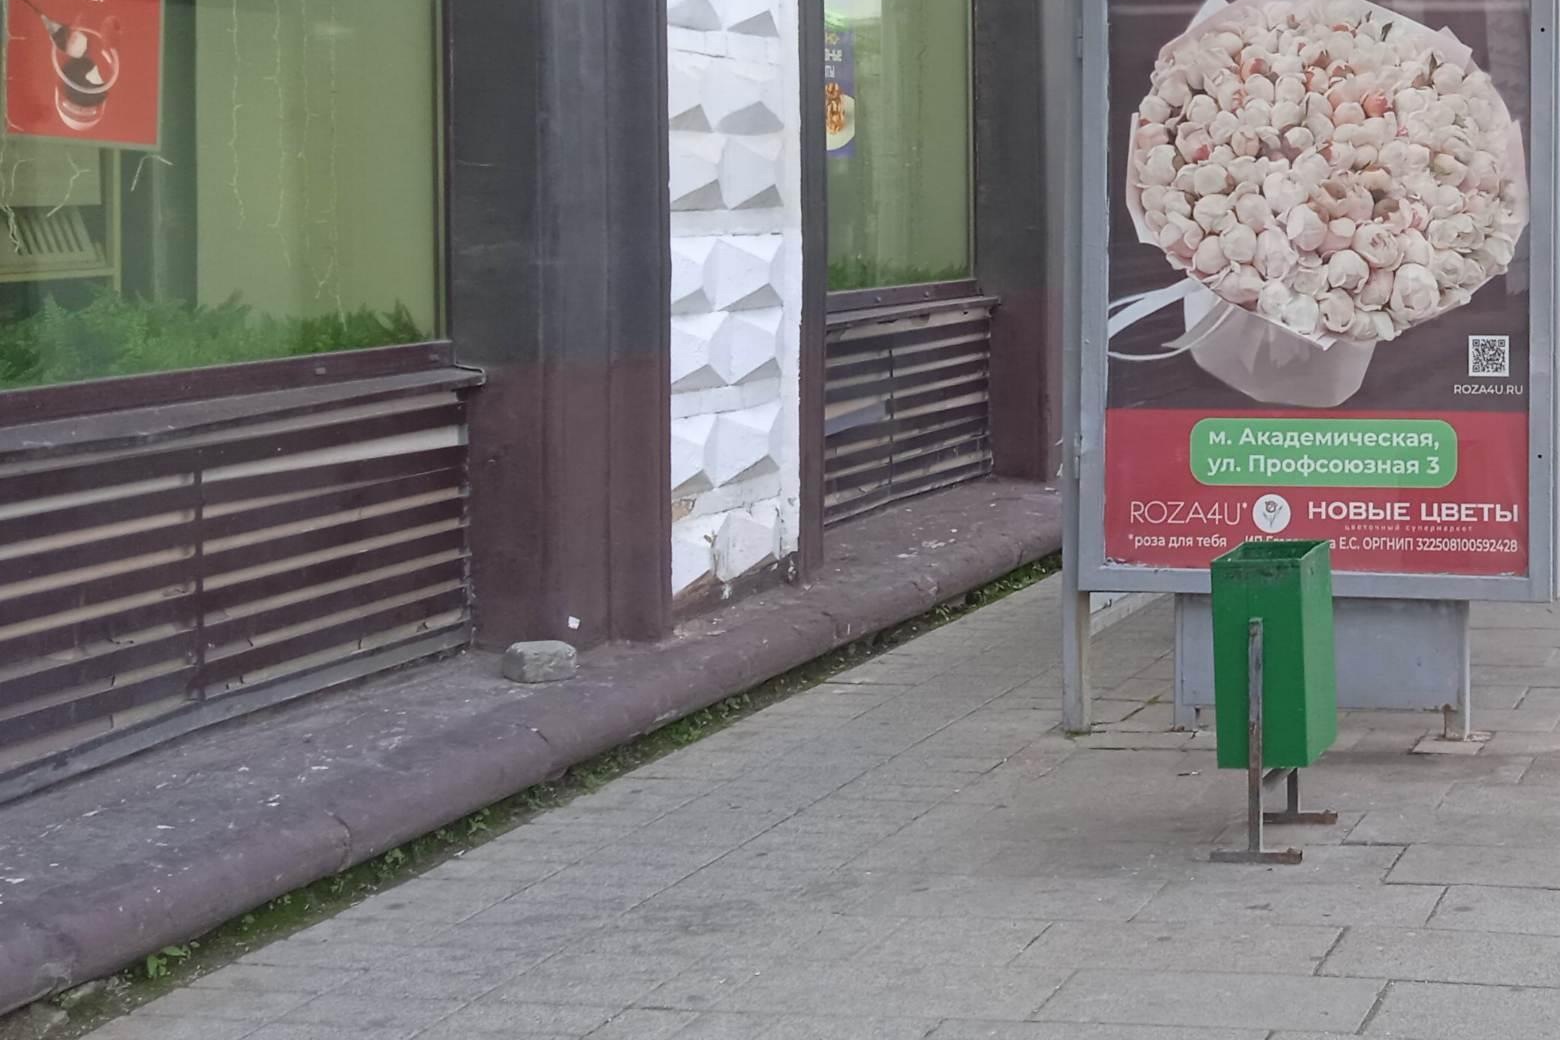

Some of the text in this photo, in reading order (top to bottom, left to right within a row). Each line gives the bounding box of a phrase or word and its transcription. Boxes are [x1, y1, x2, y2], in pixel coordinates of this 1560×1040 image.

[1454, 384, 1523, 395] ROZA4U.RU
[1209, 428, 1440, 450] м. Академическая,
[1207, 454, 1440, 477] ул. Профсоюзная 3
[1308, 501, 1518, 523] НОВЫЕ ЦВЕТЫ
[1169, 536, 1193, 548] для
[1197, 534, 1227, 548] тебя
[1363, 537, 1413, 551] ОРГНИП
